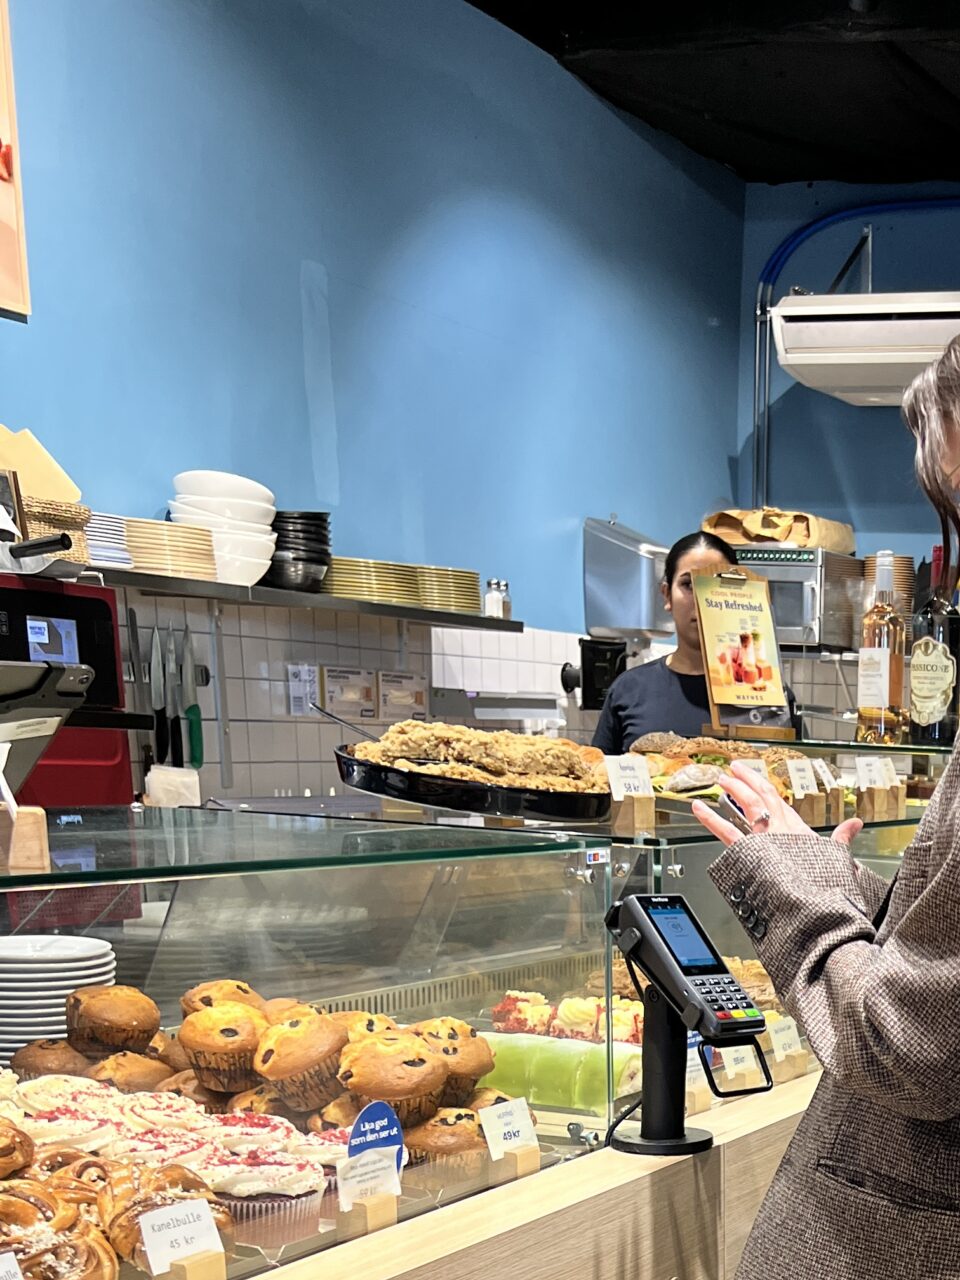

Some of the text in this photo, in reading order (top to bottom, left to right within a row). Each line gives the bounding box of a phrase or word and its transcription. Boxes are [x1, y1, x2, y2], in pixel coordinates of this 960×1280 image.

[705, 598, 764, 612] Stay Refreshed
[633, 783, 640, 793] kr
[360, 1118, 388, 1132] Lika god
[351, 1126, 399, 1146] som den ser ut
[503, 1130, 521, 1142] 49 kr
[151, 1212, 203, 1234] Kanelbulle
[169, 1234, 196, 1249] 45 kr
